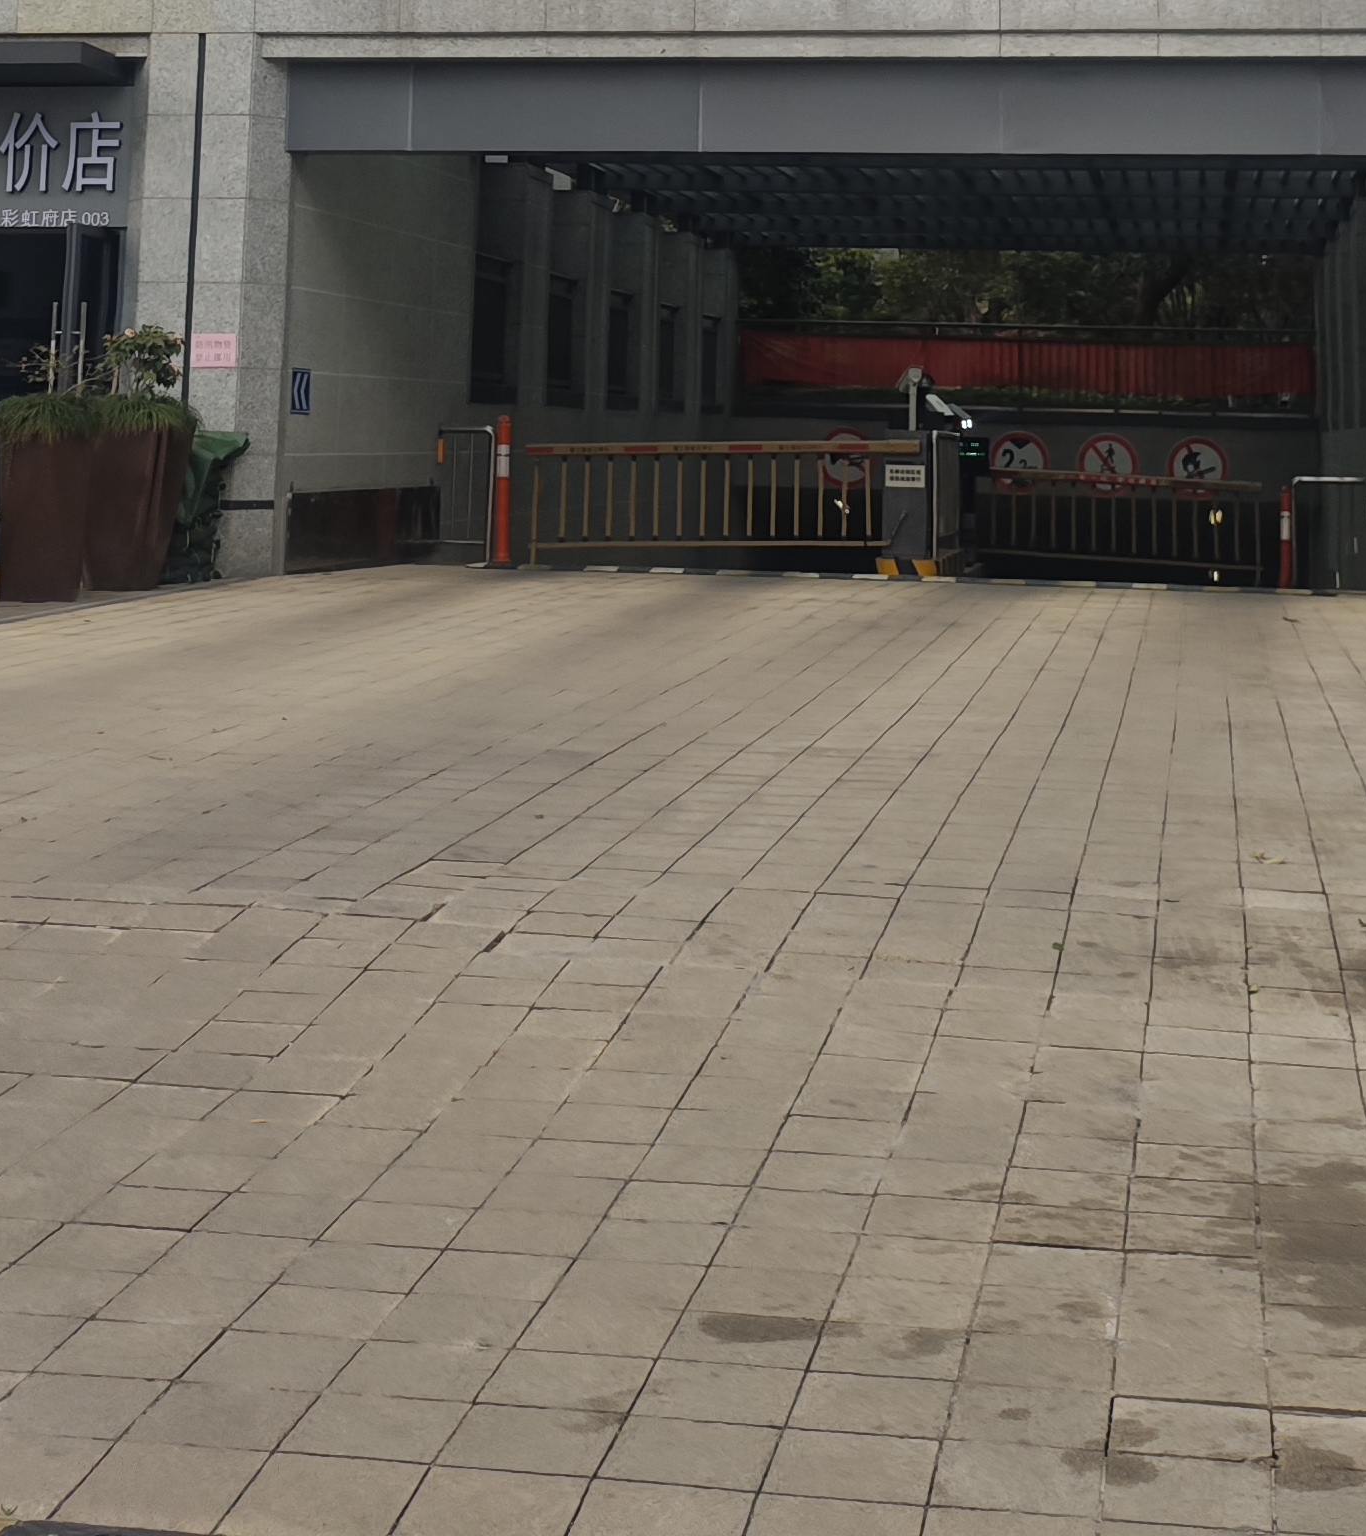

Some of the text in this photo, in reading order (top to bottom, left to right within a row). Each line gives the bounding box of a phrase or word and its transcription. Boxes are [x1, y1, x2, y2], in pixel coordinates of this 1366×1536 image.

[0, 209, 110, 227] 彩虹府店 003
